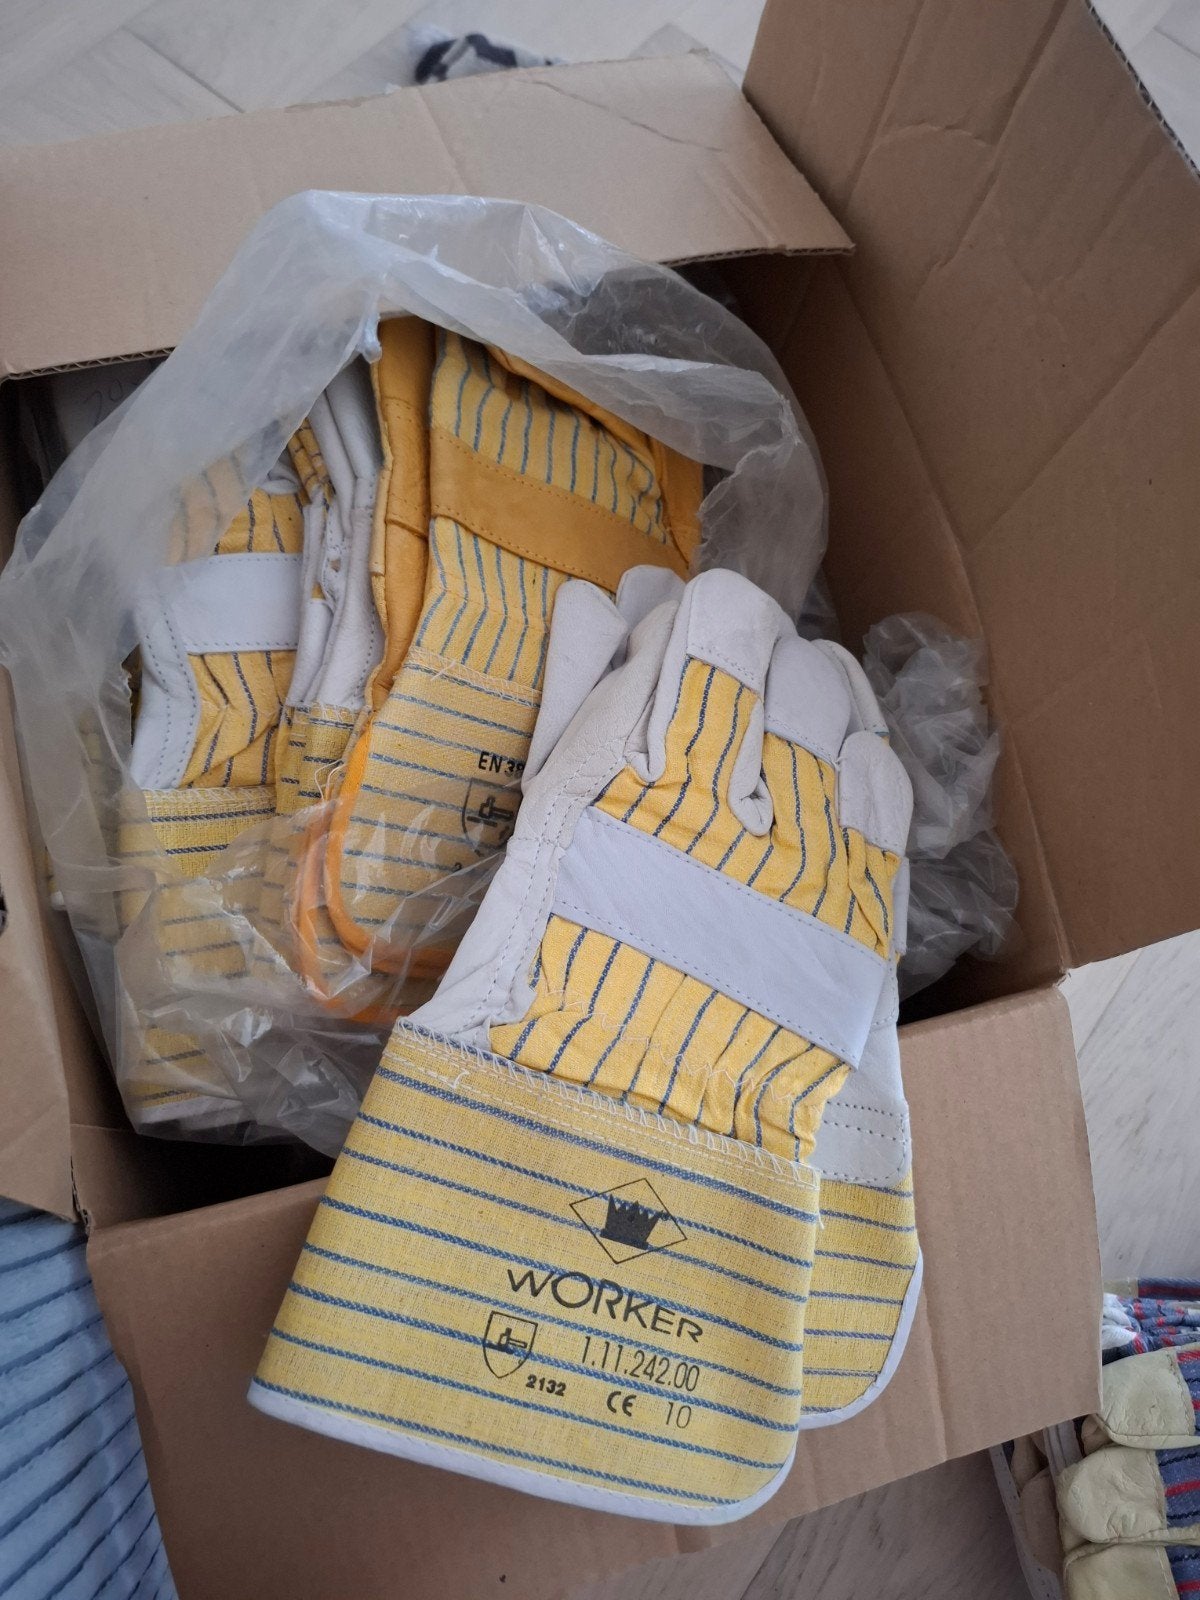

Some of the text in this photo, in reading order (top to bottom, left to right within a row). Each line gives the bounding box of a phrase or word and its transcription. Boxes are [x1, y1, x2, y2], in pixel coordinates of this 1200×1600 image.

[478, 751, 502, 773] EN
[507, 1269, 703, 1342] WORKER
[581, 1336, 700, 1392] 1.11.242.00
[525, 1374, 567, 1397] 2132
[607, 1391, 692, 1429] CE 10
